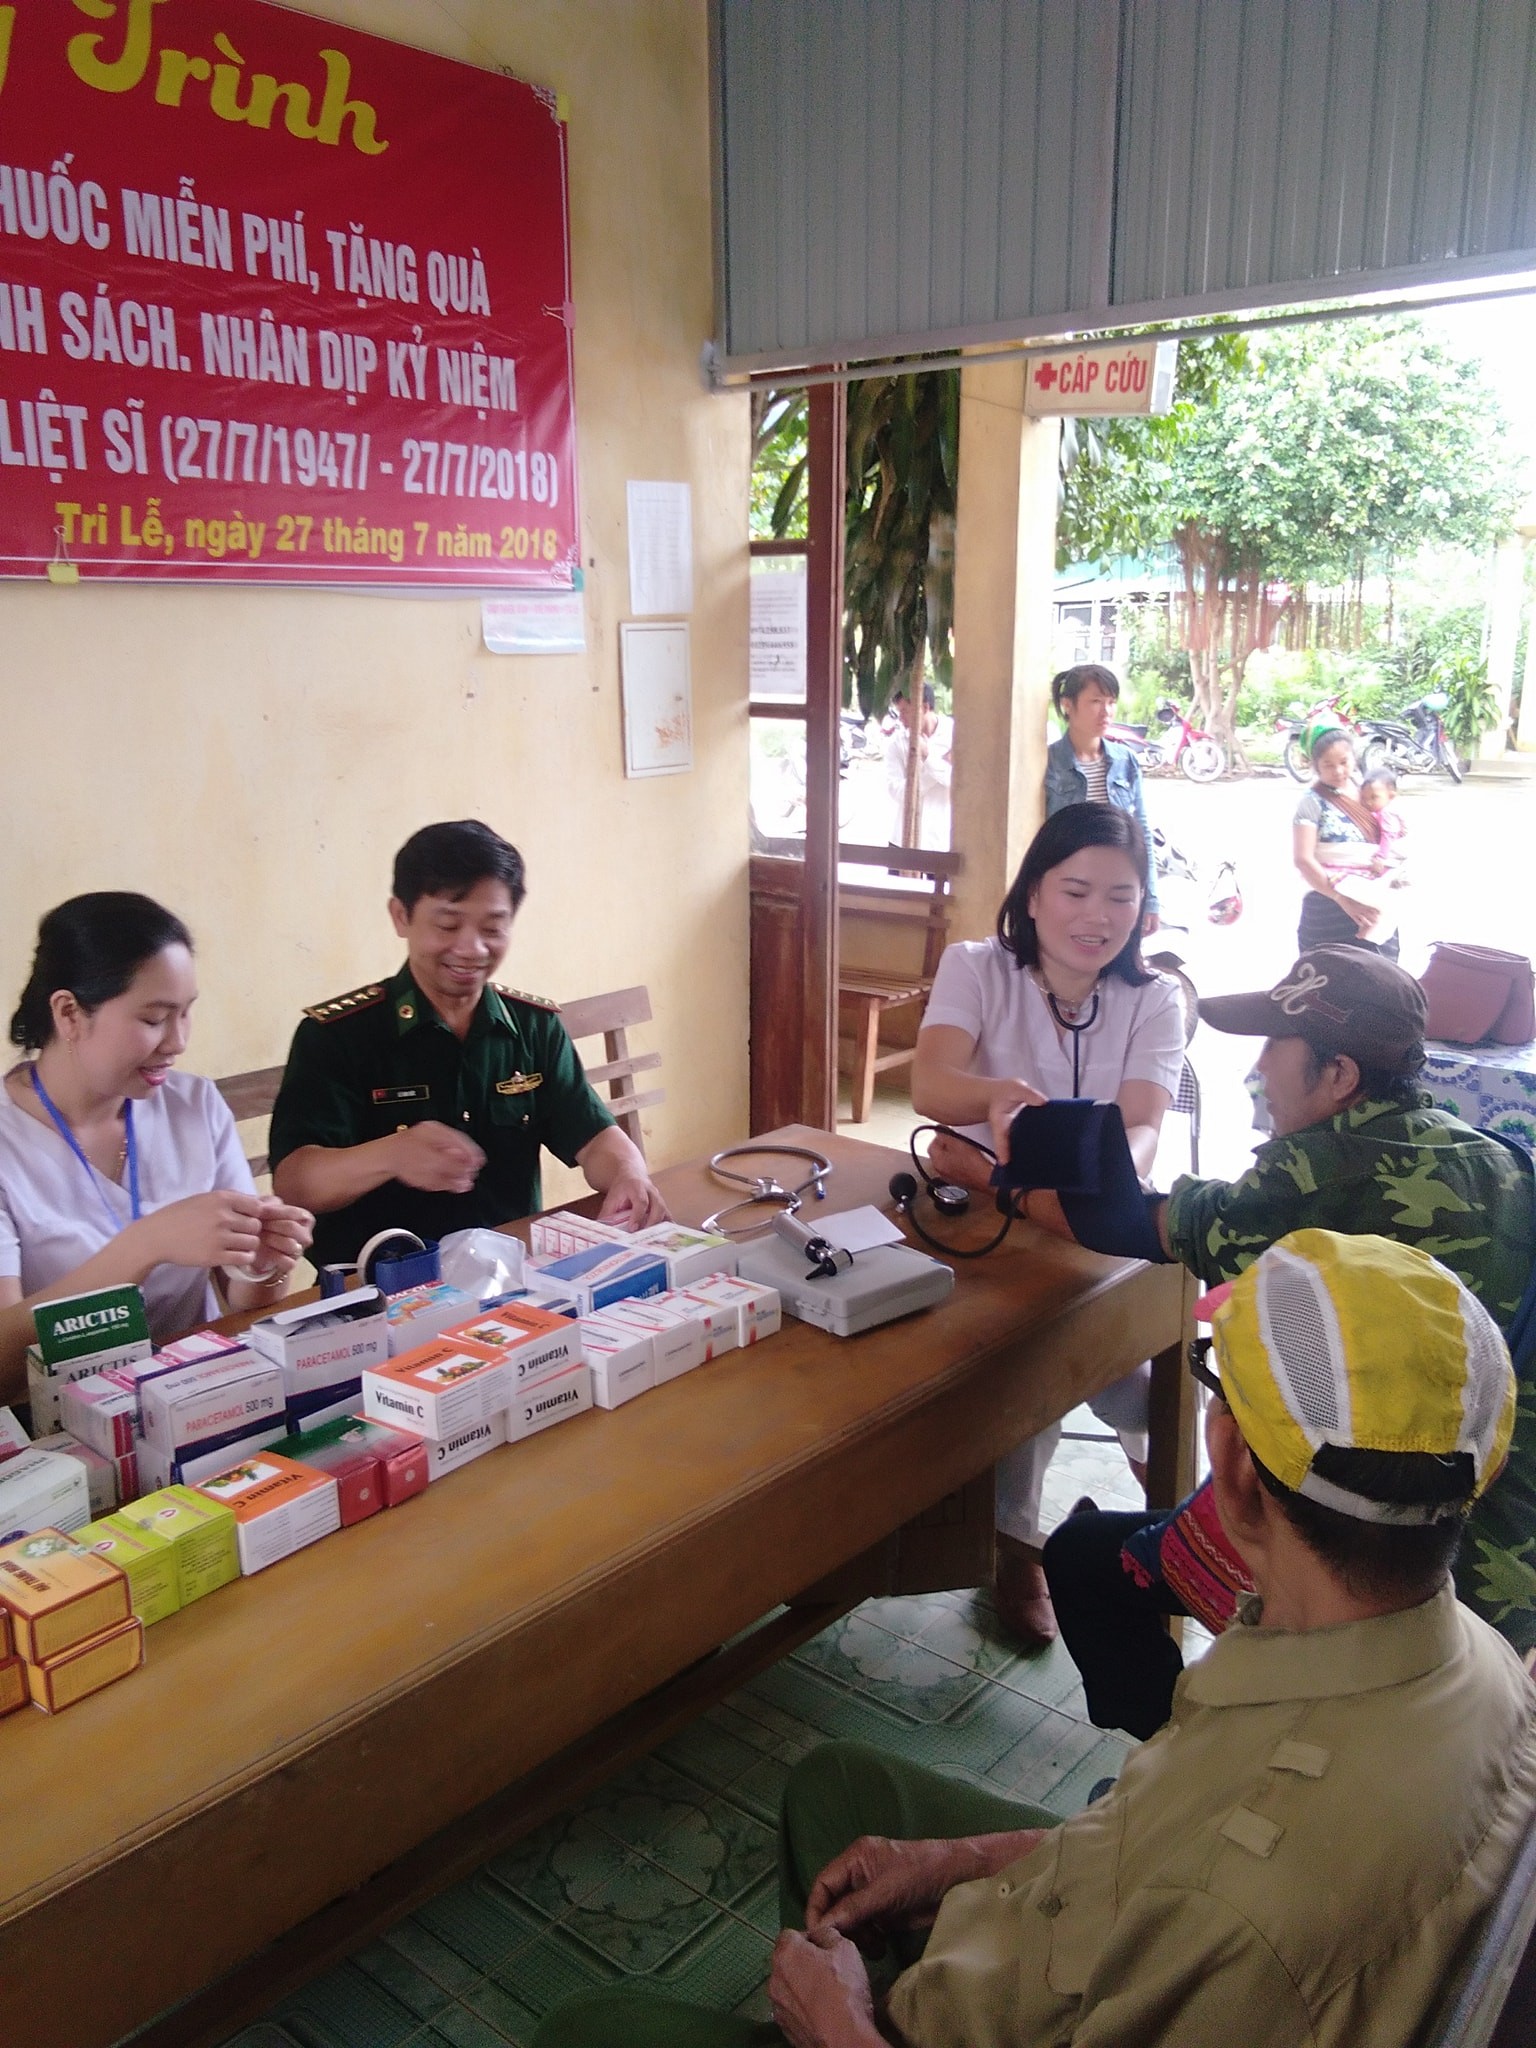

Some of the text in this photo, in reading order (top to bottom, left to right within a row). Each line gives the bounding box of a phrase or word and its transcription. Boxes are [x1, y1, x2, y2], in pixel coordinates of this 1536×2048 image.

[67, 0, 389, 155] Trình
[121, 176, 233, 272] MIỄN
[242, 210, 319, 294] PHÍ,
[326, 221, 419, 309] TẶNG
[427, 247, 491, 317] QUÀ
[59, 282, 191, 373] SÁCH.
[200, 308, 311, 388] NHÂN
[319, 330, 378, 406] DỊP
[386, 324, 428, 401] KỶ
[437, 341, 517, 420] NIỆM
[1058, 351, 1147, 394] CẤP CỨU
[0, 388, 88, 483] LIỆT
[102, 398, 148, 475] SĨ
[160, 414, 371, 491] (27/7/1947/
[402, 438, 558, 508] 27/7/2018)
[55, 498, 558, 562] Tri Lễ, ngày 27 tháng 7 năm 2018
[53, 1305, 131, 1337] ARICTIS
[296, 1341, 378, 1371] PARACETAMOL 500 mg
[518, 1345, 569, 1377] Vitamin C
[186, 1396, 274, 1433] PARACETAMOL 500 mg
[375, 1390, 424, 1419] Vitamin C
[525, 1389, 579, 1421] Vitamin C
[438, 1424, 492, 1461] Vitamin C
[232, 1499, 247, 1509] C
[247, 1473, 304, 1501] Vitamin
